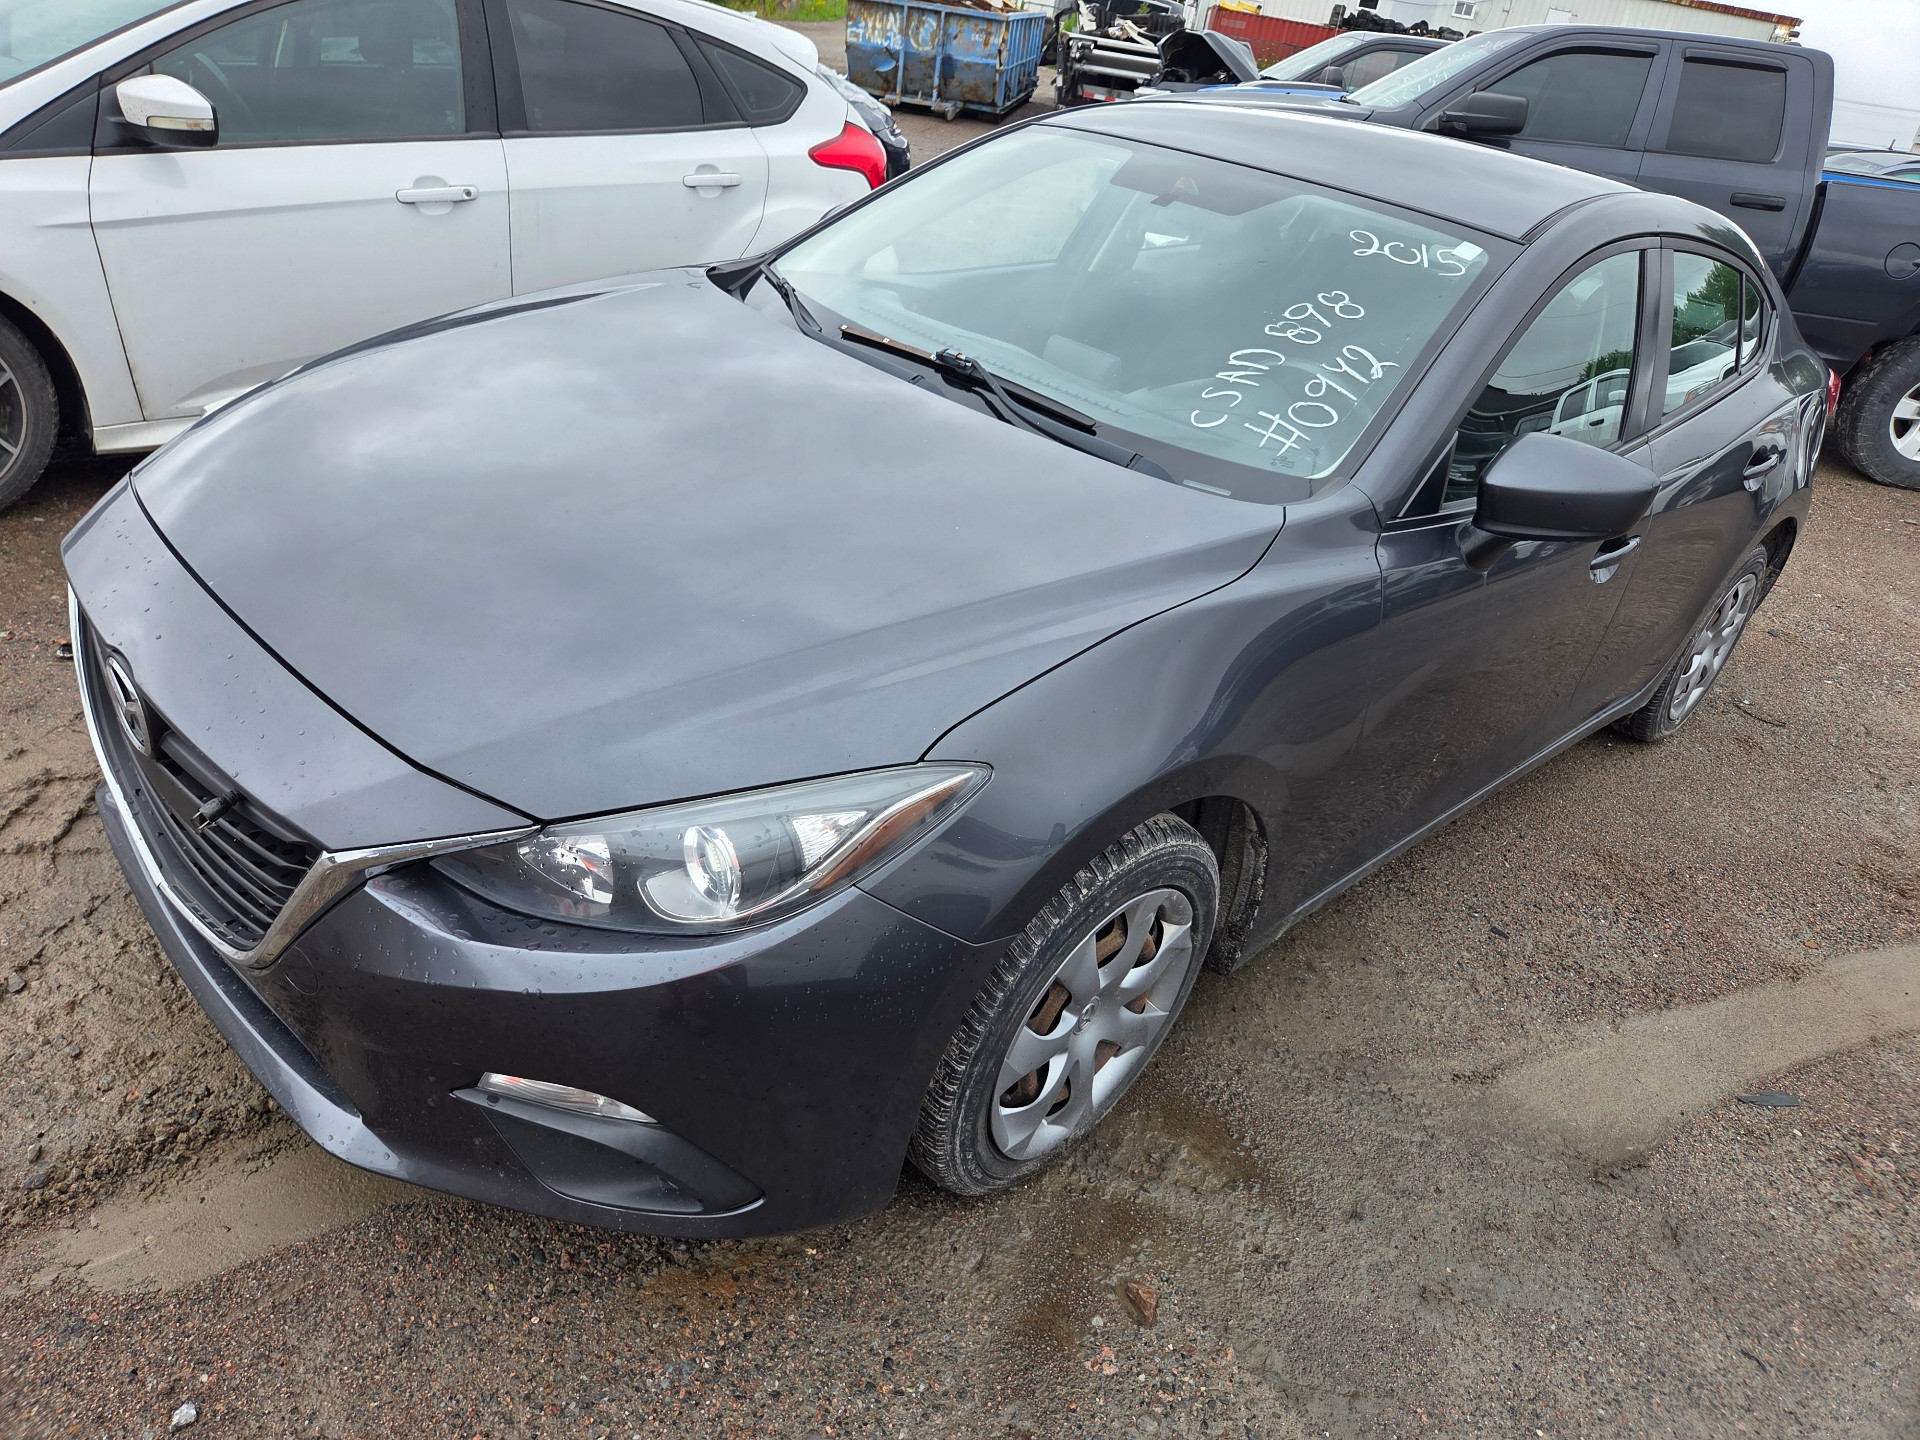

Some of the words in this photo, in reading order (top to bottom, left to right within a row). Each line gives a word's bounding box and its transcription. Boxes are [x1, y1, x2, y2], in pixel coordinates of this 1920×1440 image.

[1349, 229, 1466, 277] 2015
[1264, 290, 1365, 345] 898
[1243, 344, 1400, 457] #0942
